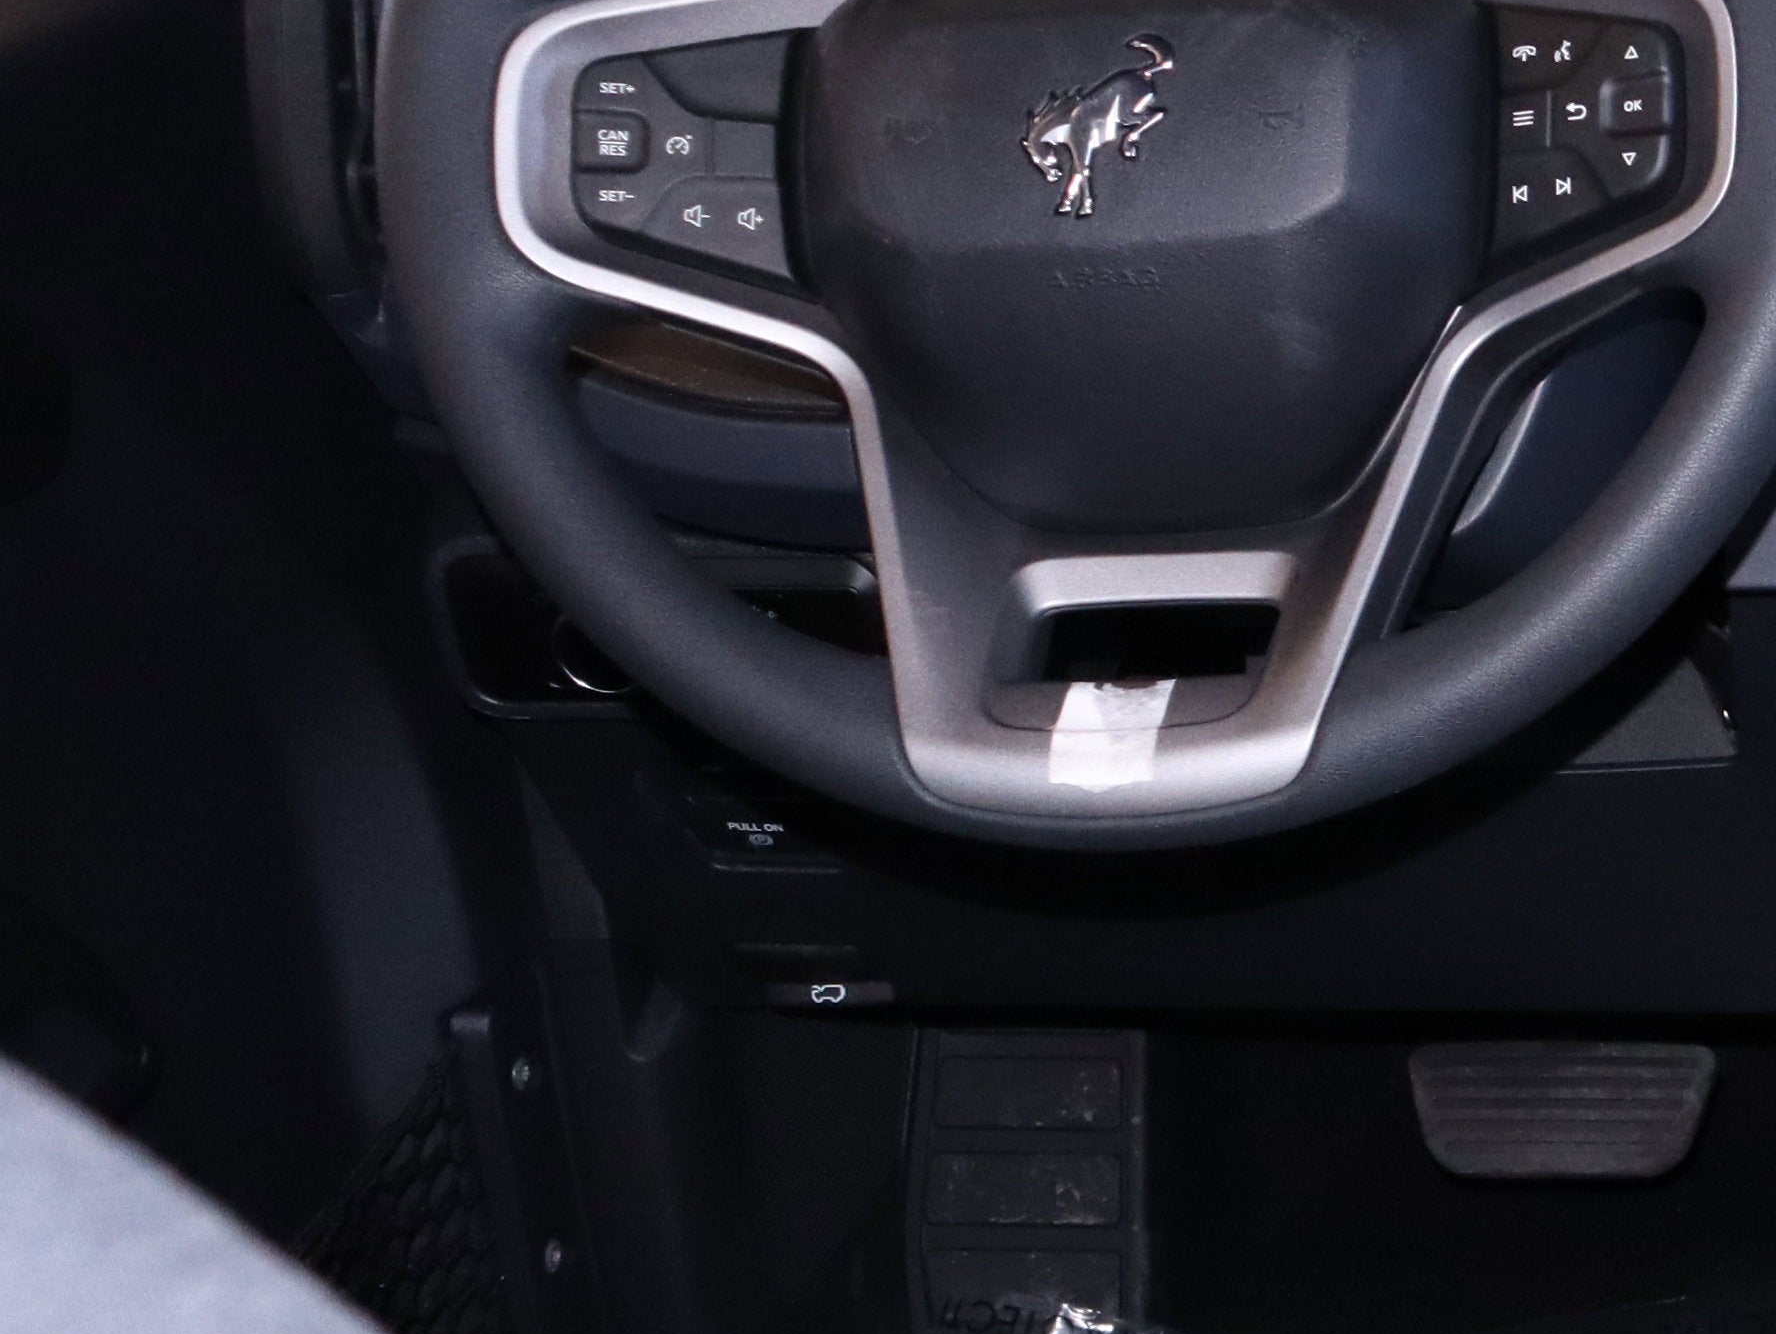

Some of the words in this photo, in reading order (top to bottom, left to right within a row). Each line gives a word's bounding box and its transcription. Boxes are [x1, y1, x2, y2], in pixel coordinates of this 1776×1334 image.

[1623, 99, 1644, 112] OK
[598, 130, 628, 141] CAN
[599, 145, 627, 156] RES
[726, 821, 761, 833] PULL
[763, 823, 784, 833] ON
